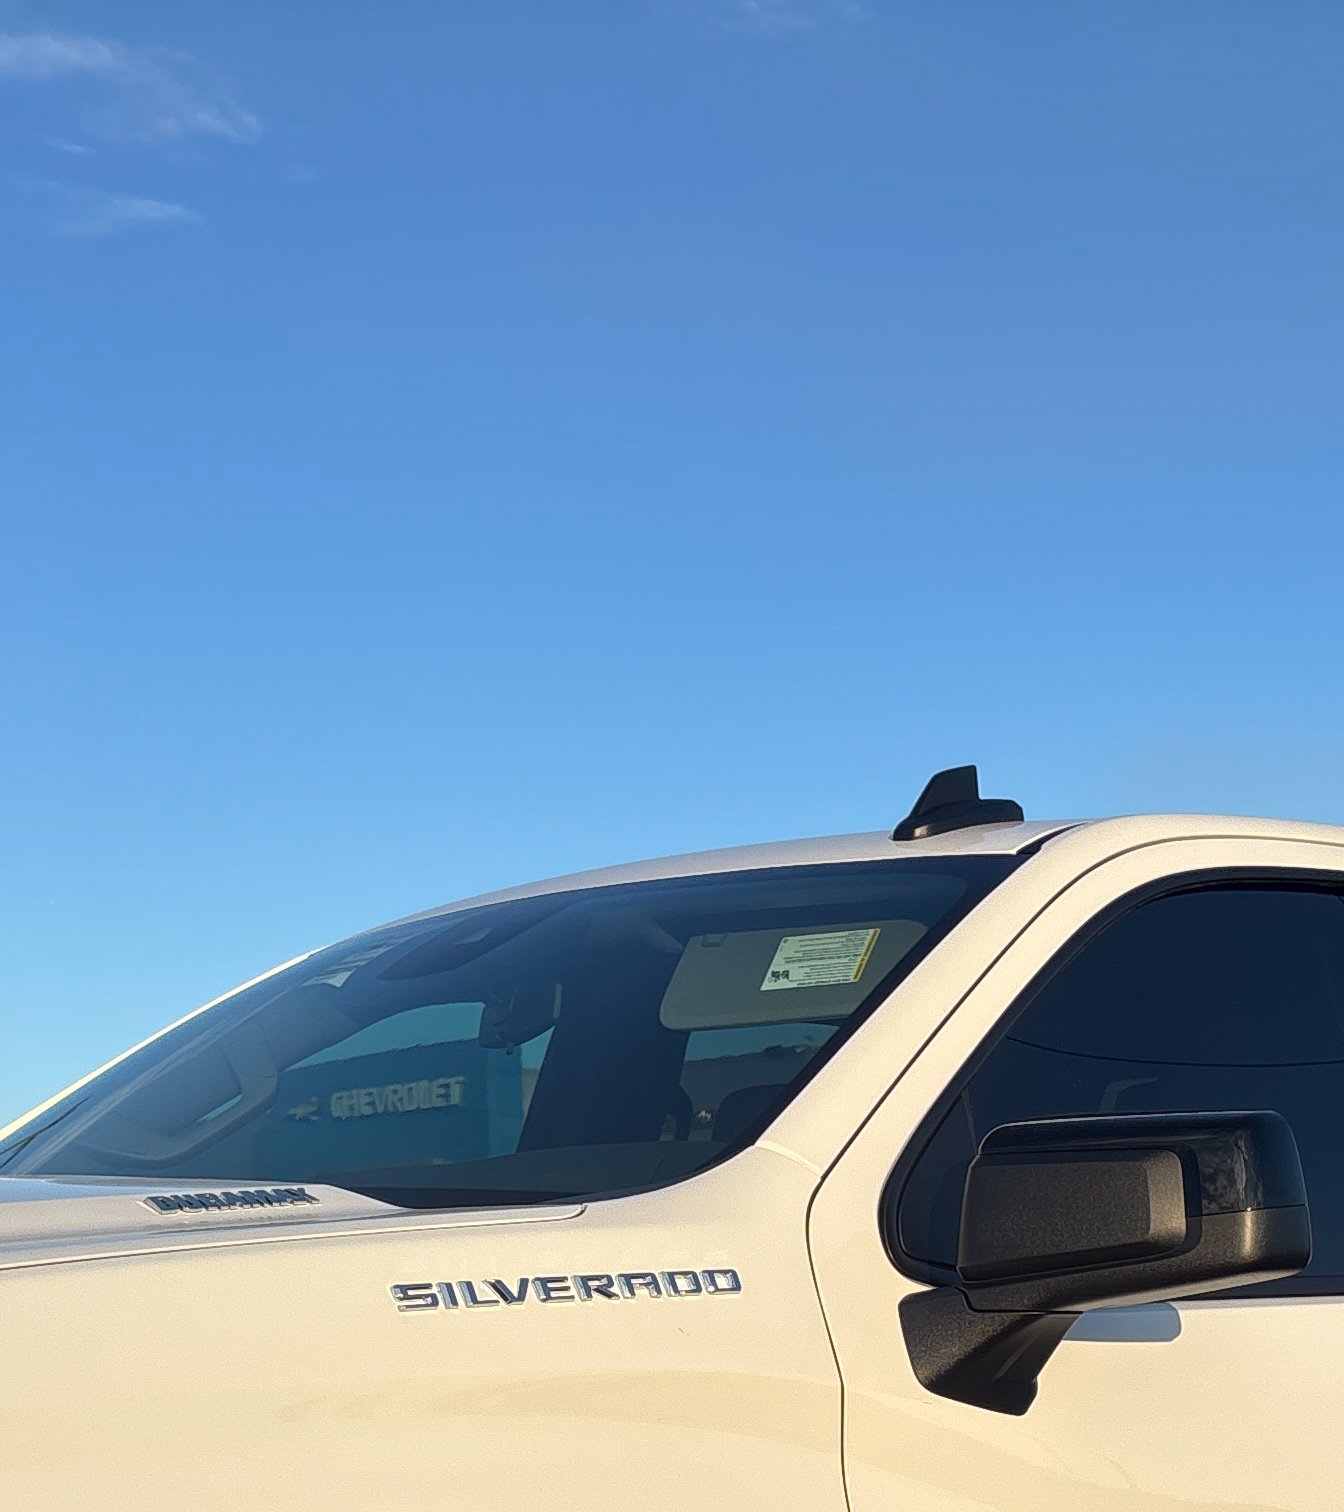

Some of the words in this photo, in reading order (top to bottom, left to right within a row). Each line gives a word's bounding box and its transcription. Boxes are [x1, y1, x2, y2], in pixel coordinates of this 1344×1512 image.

[331, 1076, 465, 1120] CHEVROLET
[142, 1187, 320, 1215] DURAMAX
[390, 1269, 742, 1313] SILVERADO
